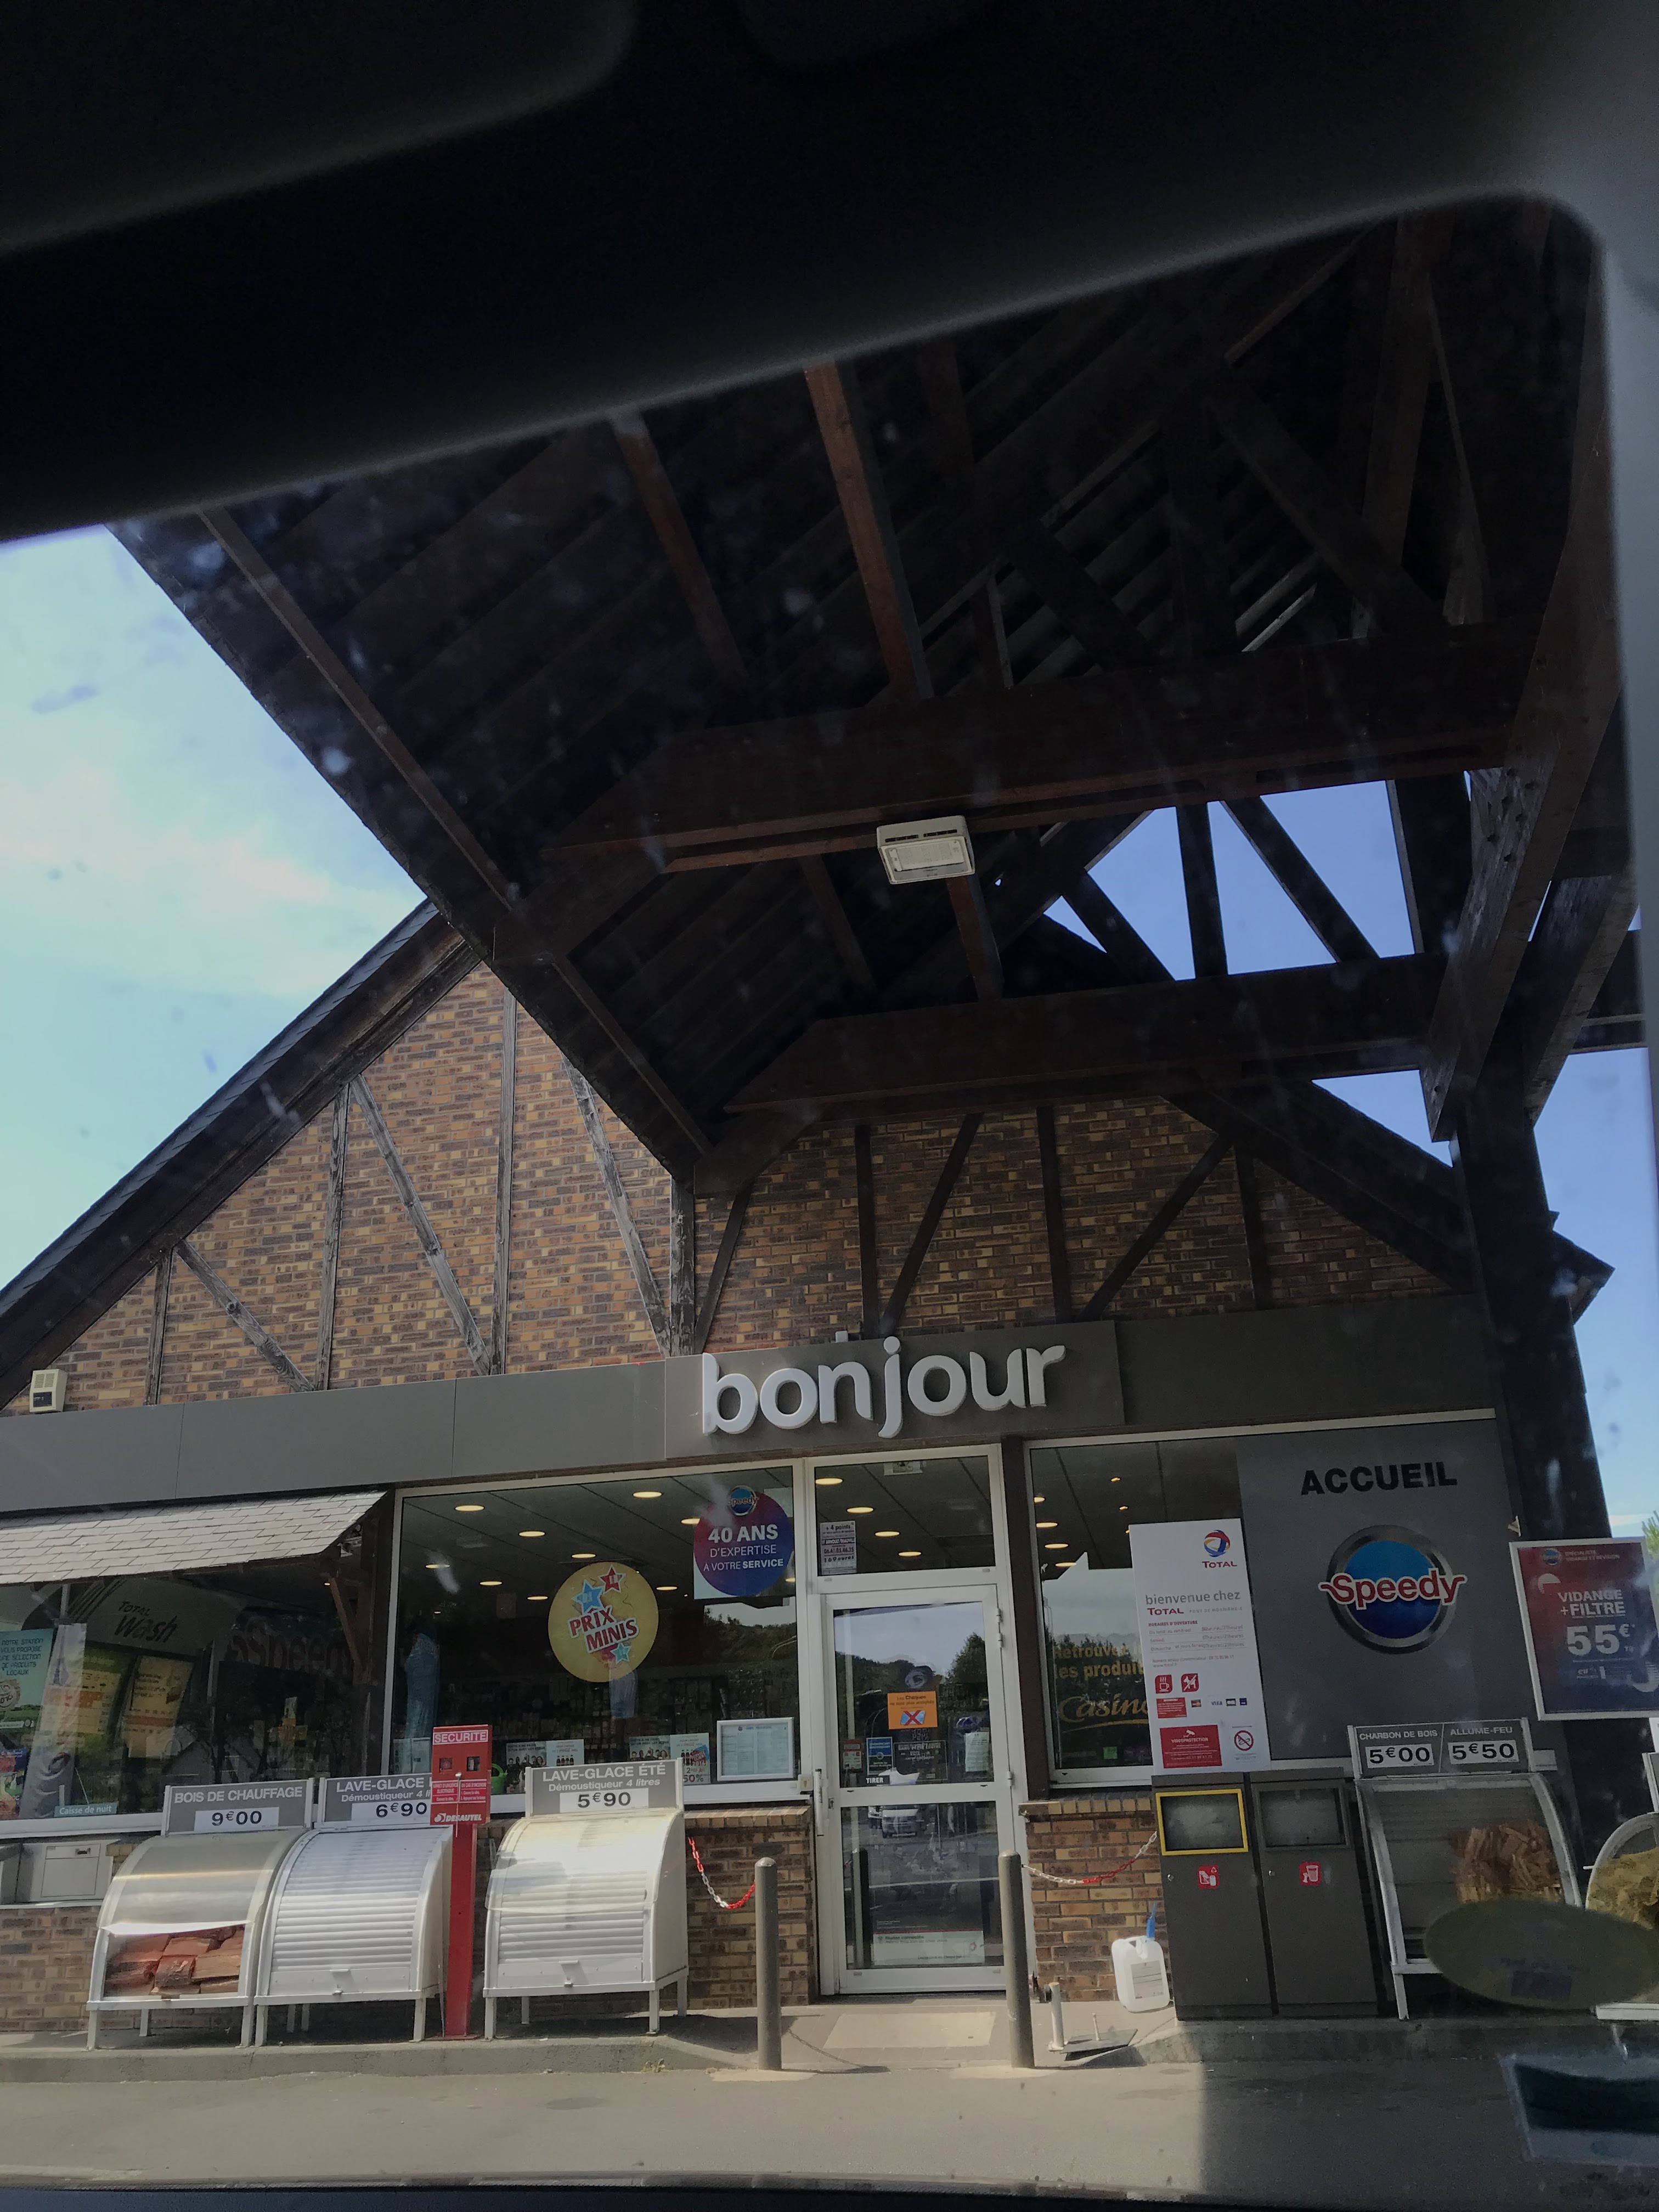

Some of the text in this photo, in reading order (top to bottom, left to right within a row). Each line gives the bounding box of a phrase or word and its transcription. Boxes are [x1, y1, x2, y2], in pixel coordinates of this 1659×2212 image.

[702, 1336, 1066, 1438] bonjour
[1301, 1462, 1457, 1495] ACCUEIL
[708, 1523, 778, 1543] 40 ANS
[710, 1544, 777, 1558] D'EXPERTISE
[712, 1561, 741, 1571] VOTRE
[742, 1558, 783, 1569] SERVICE
[1318, 1568, 1467, 1610] Speedy
[1558, 1589, 1623, 1602] VIDANGE
[1146, 1590, 1241, 1605] bienvenue chez
[119, 1601, 151, 1616] TOTAL
[114, 1615, 178, 1643] Wash
[586, 1620, 637, 1651] MINIS
[435, 1731, 486, 1743] SECURITE
[1359, 1729, 1438, 1740] CHARBON DE BOIS
[1450, 1726, 1513, 1736] ALLUME-FEU
[1370, 1747, 1430, 1764] 5€00
[1452, 1743, 1515, 1760] 5€50
[543, 1763, 666, 1782] LAVE-GLACE ÉTÉ
[336, 1777, 424, 1793] LAVE-GLACE
[549, 1780, 623, 1792] Démoustiqueur
[635, 1778, 661, 1787] litres
[174, 1787, 303, 1803] BOIS DE CHAUFFAGE
[341, 1791, 413, 1802] Démoustiqueur
[578, 1792, 631, 1808] 5€90
[376, 1802, 427, 1818] 6€90
[212, 1811, 262, 1826] 9€00
